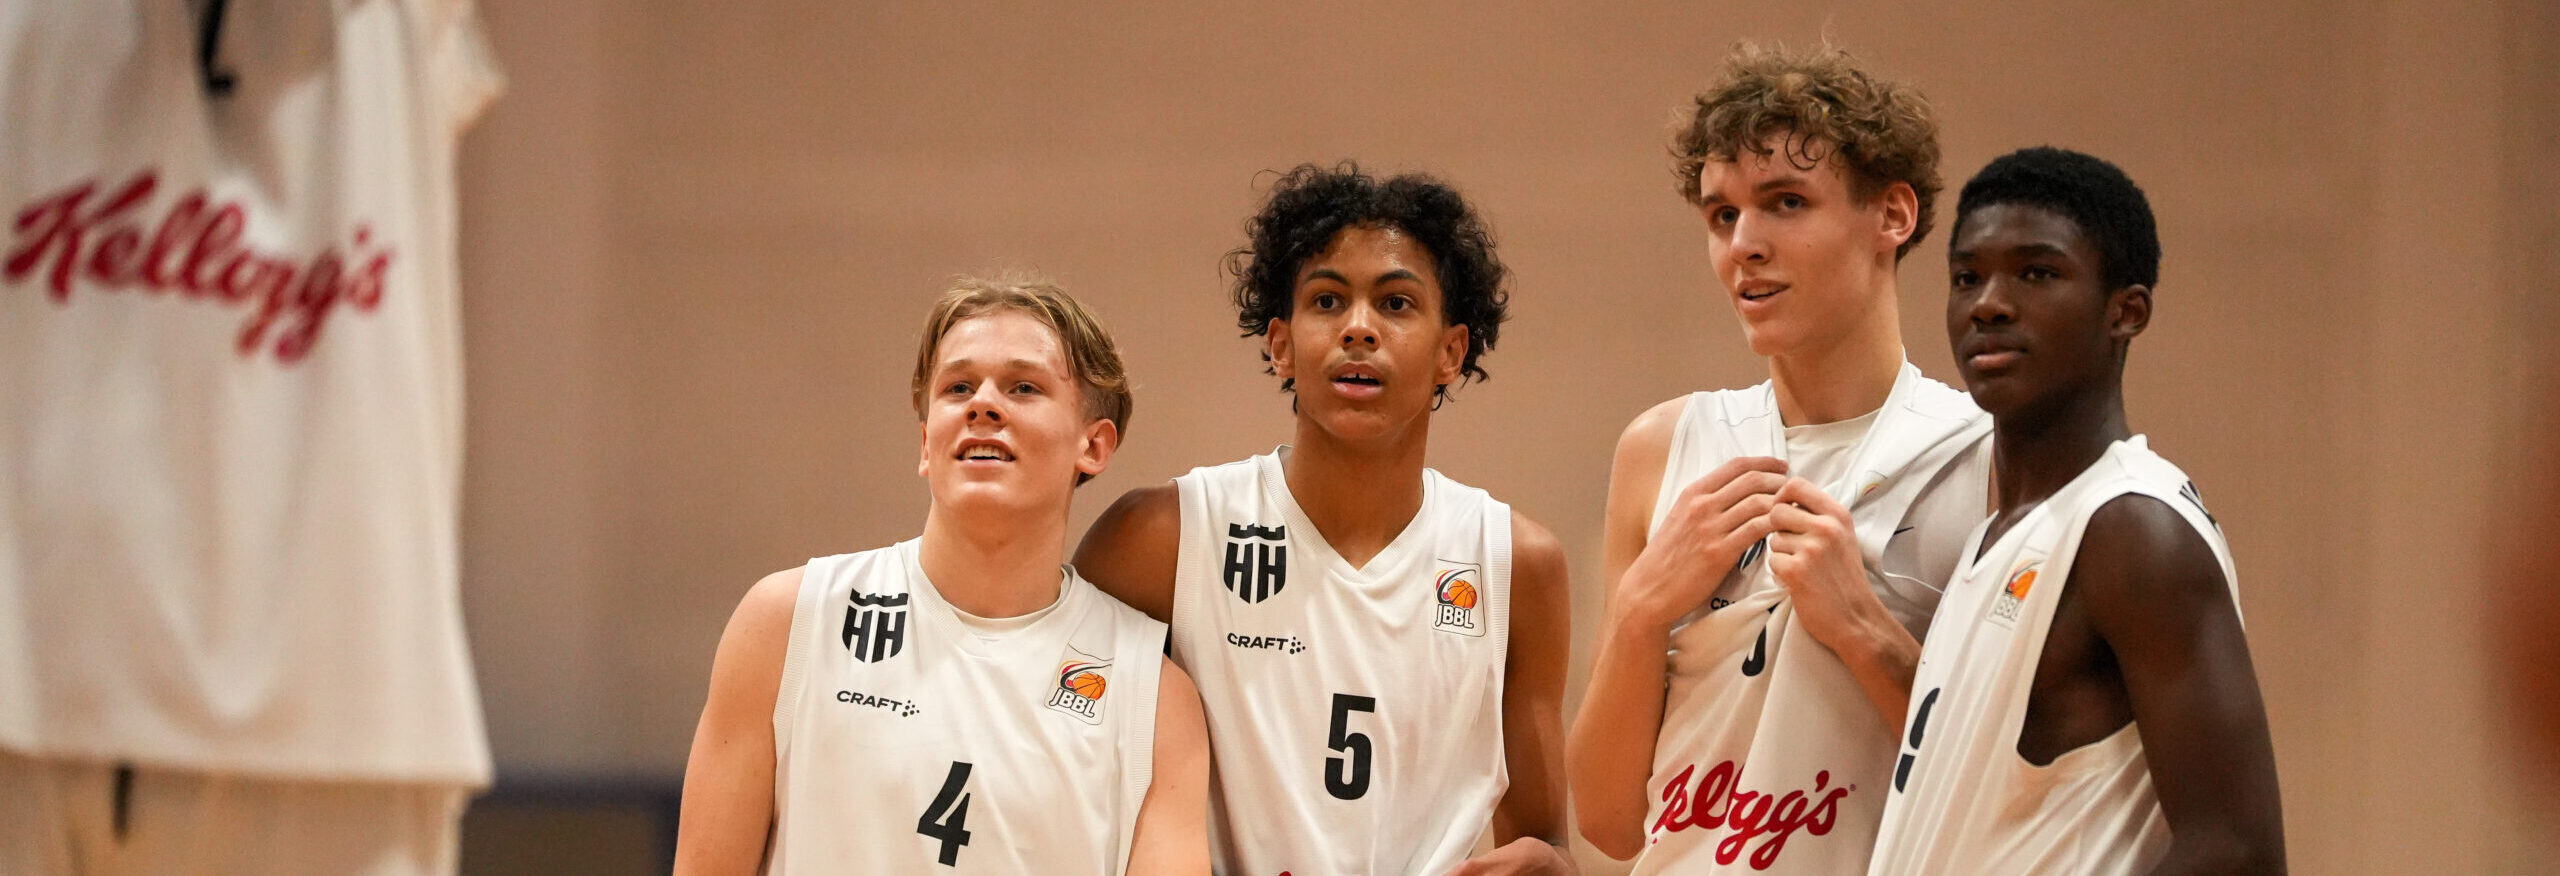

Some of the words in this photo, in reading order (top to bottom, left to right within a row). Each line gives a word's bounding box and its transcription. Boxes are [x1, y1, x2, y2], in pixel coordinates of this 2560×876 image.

[3, 165, 394, 366] Kellogg's
[1223, 541, 1287, 605] HH
[841, 604, 907, 663] HH
[1227, 632, 1289, 651] CRAFT
[1435, 603, 1475, 629] JBBL
[836, 690, 903, 713] CRAFT
[1048, 687, 1095, 718] JBBL
[1324, 693, 1376, 801] 5
[916, 760, 973, 868] 4
